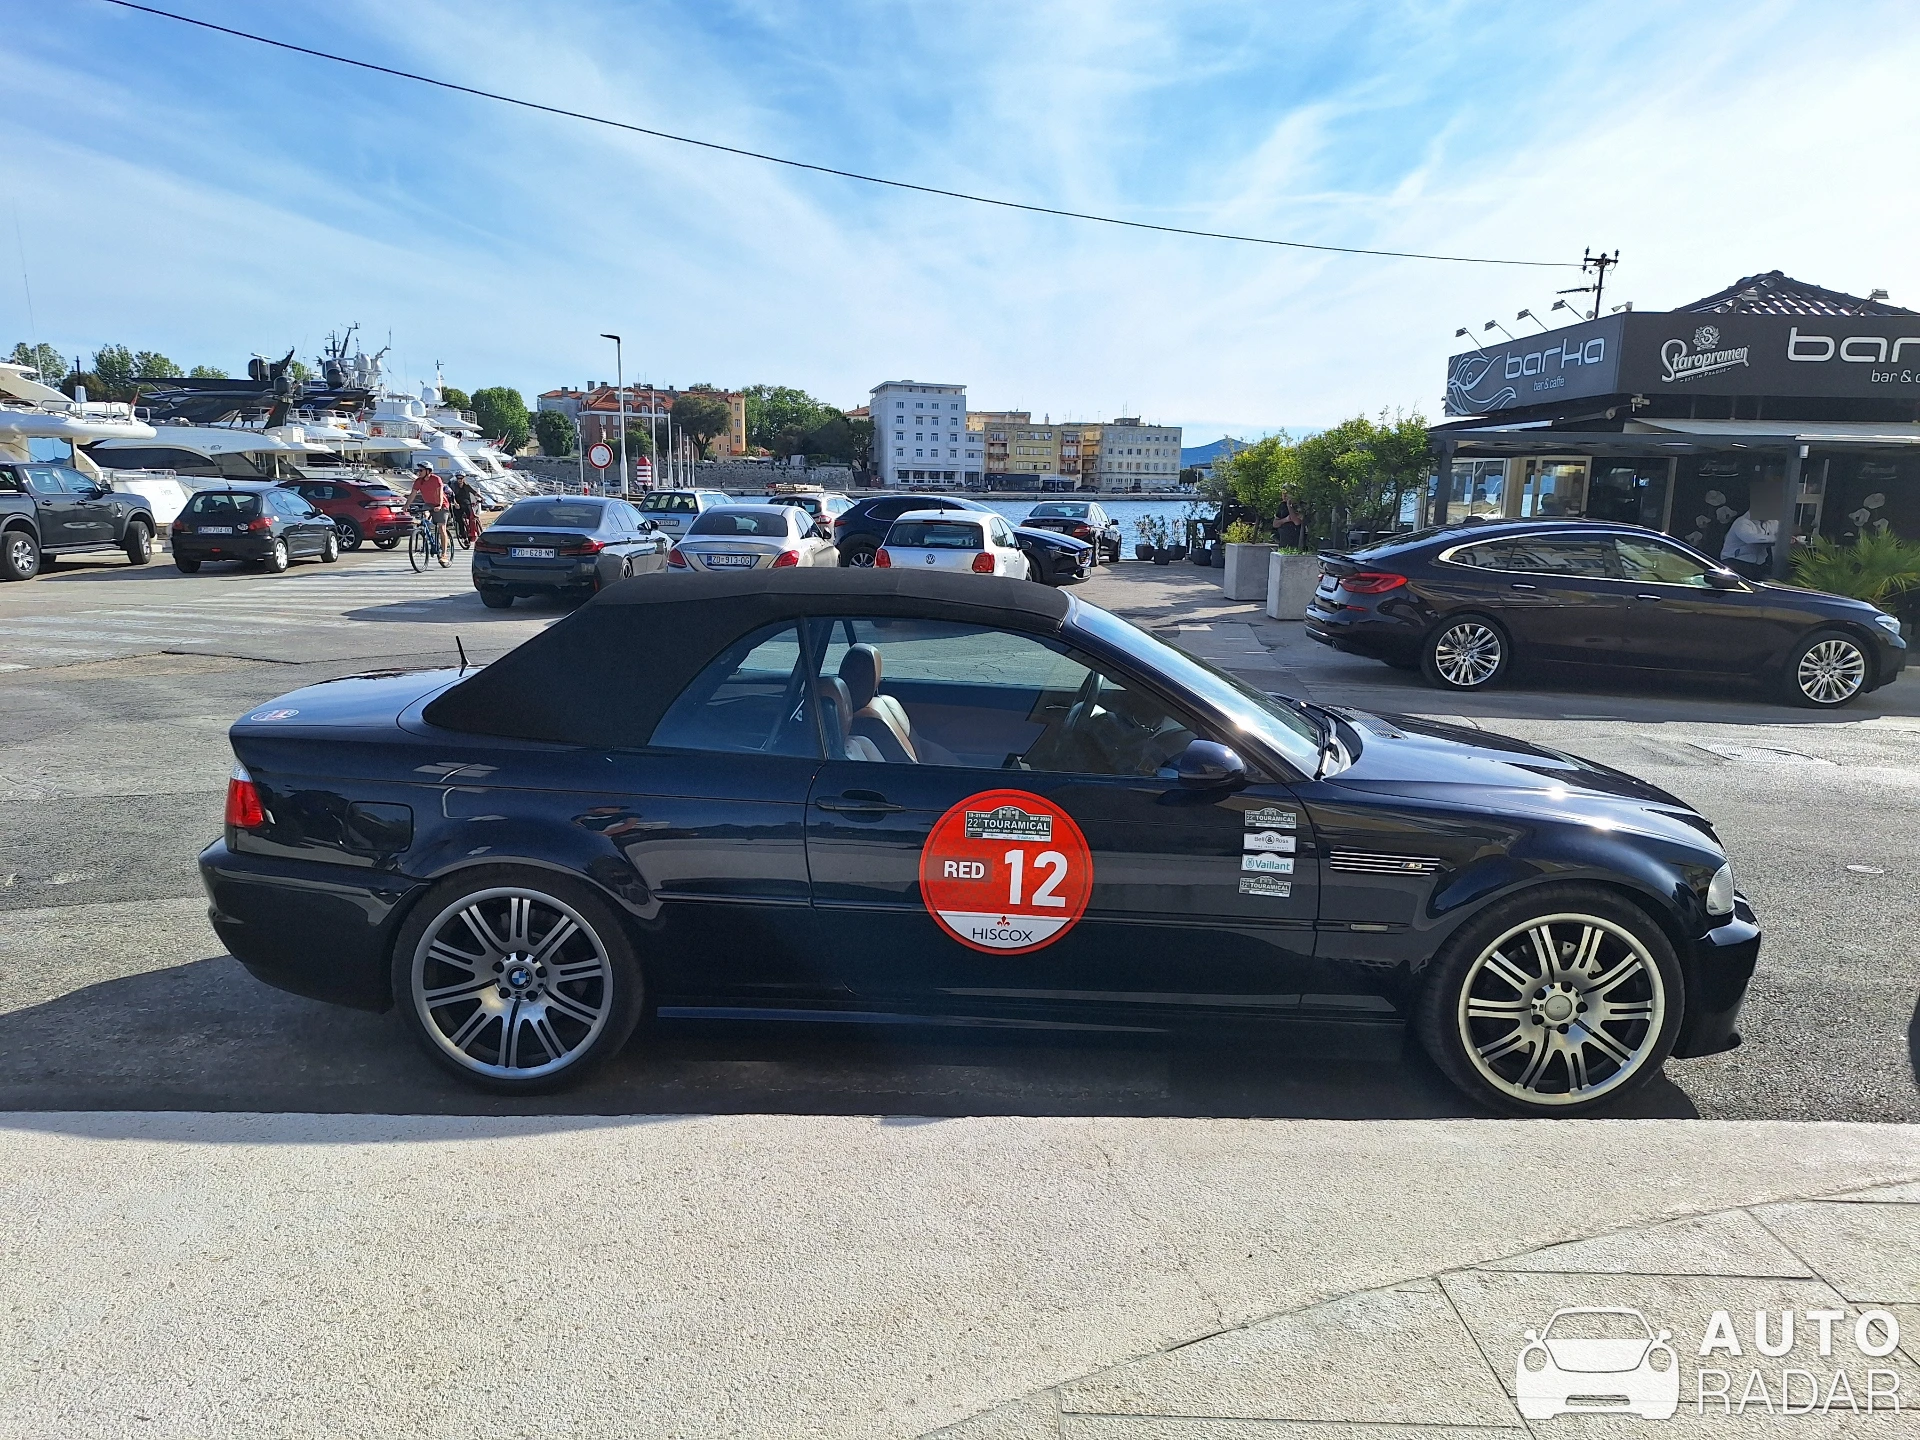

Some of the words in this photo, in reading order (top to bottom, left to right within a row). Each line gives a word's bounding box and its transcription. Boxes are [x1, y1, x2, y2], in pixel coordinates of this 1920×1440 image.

[1505, 337, 1604, 379] barka
[1661, 339, 1749, 382] Staropramen
[1533, 380, 1544, 392] bar
[1549, 376, 1565, 389] caffe
[1871, 369, 1898, 383] bar
[1900, 369, 1912, 383] &
[983, 819, 1050, 831] TOURAMICAL
[1255, 815, 1294, 823] TOURAMICAL
[943, 860, 986, 879] RED
[1255, 859, 1291, 871] Vaillant
[1004, 849, 1068, 908] 12
[1250, 882, 1289, 891] TOURAMICAL
[972, 927, 1033, 943] HISCOX
